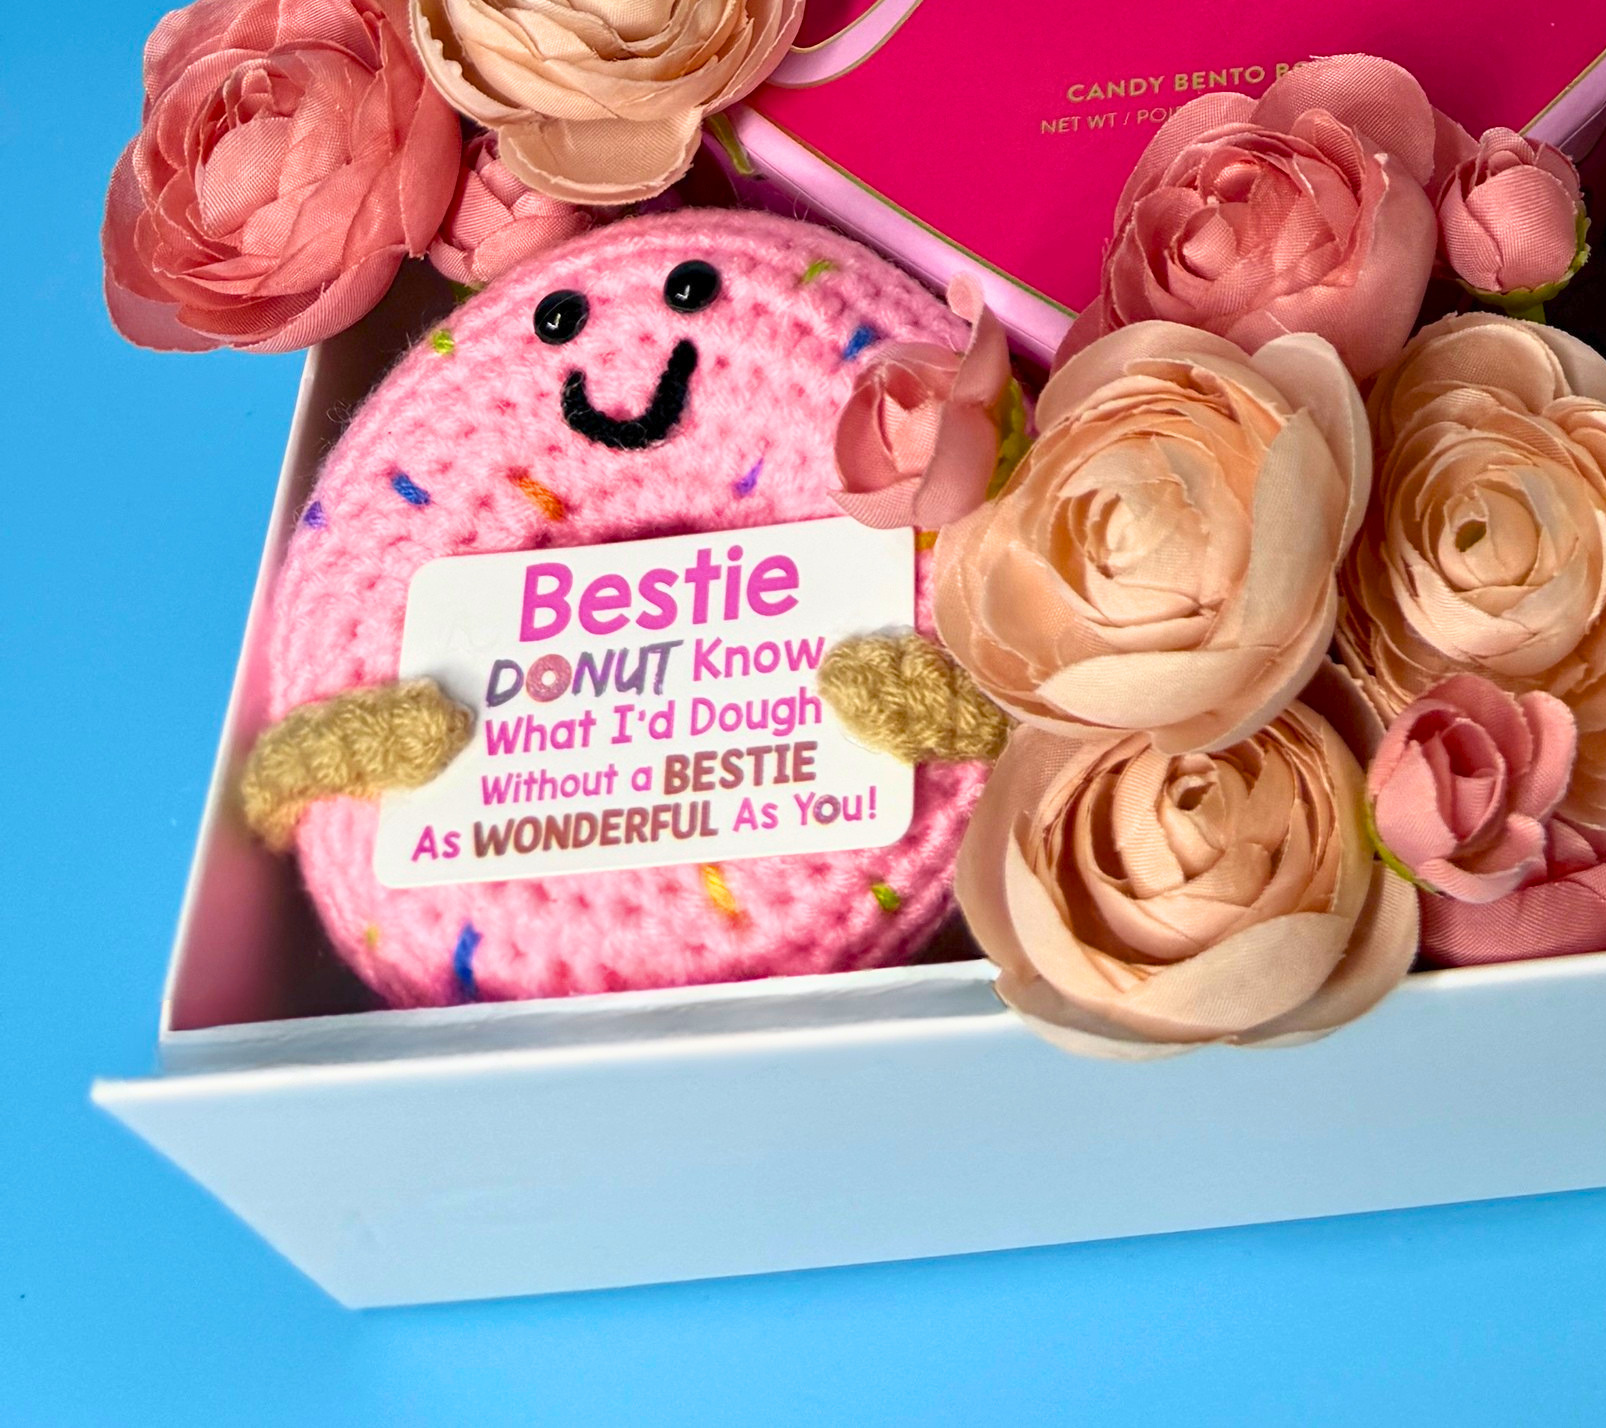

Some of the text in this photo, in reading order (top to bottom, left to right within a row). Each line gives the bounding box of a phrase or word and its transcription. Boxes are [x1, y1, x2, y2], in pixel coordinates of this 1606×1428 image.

[1066, 75, 1165, 103] CANDY
[1173, 65, 1265, 92] BENTO
[1040, 115, 1081, 134] NET
[1087, 112, 1118, 130] WT
[519, 545, 800, 642] Bestie
[485, 636, 826, 707] DONUT Know
[484, 687, 823, 757] What I'd Dough
[481, 741, 818, 806] Without a BESTIE
[411, 786, 878, 862] As WONDERFUL As You!
